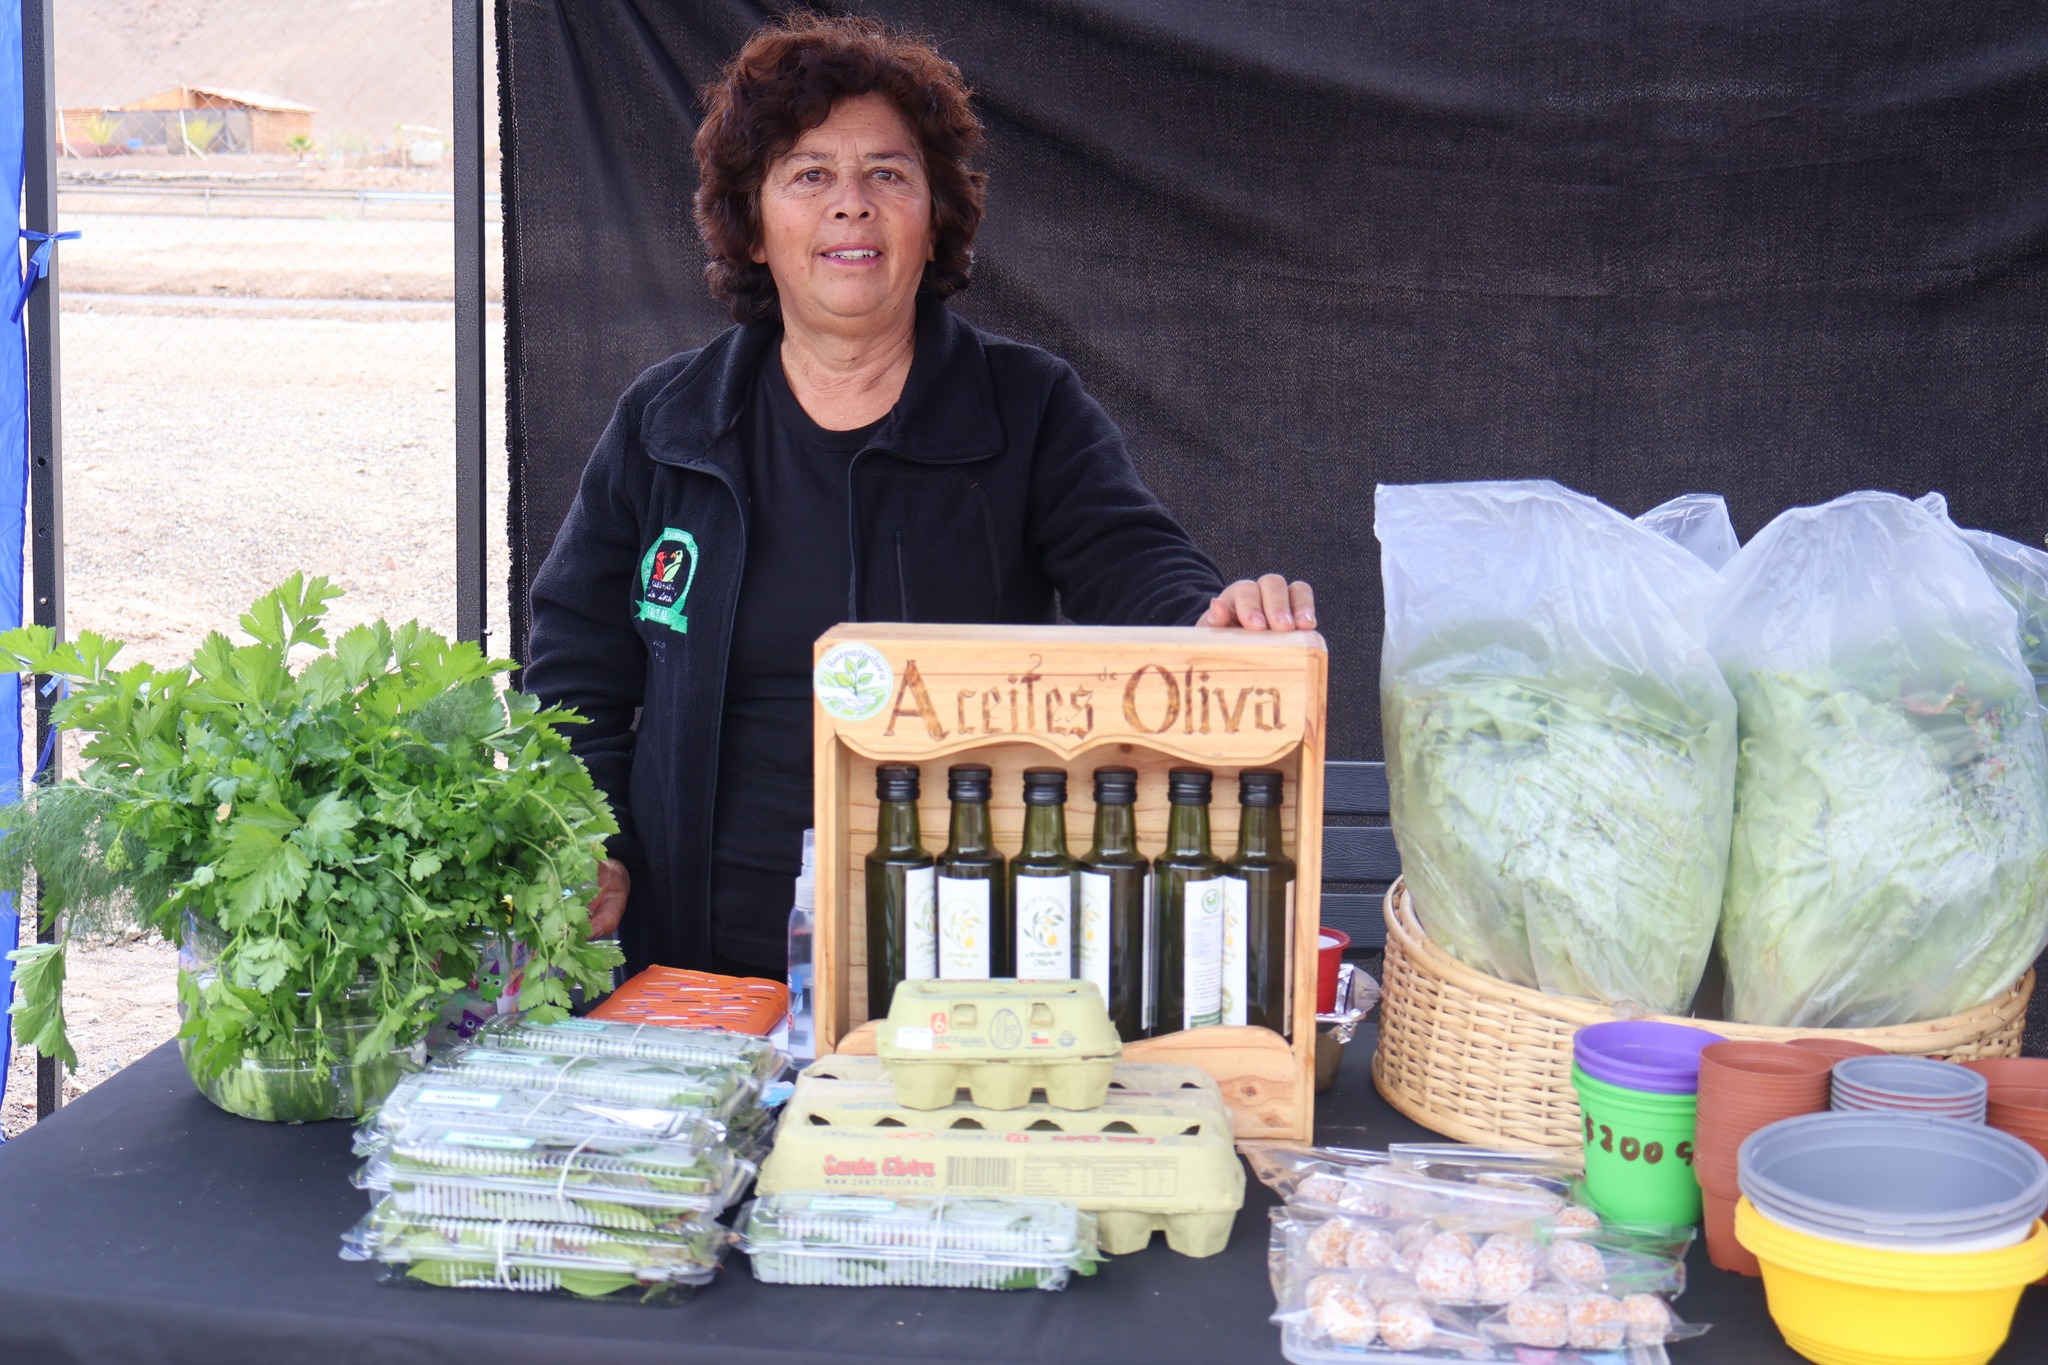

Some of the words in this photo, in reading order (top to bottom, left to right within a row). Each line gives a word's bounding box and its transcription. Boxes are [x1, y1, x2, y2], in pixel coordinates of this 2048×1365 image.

[826, 650, 886, 681] Buenaventura
[883, 653, 1094, 742] Aceites
[1097, 666, 1118, 682] de
[1122, 663, 1287, 735] Oliva
[933, 1013, 946, 1032] 6
[434, 1093, 482, 1103] ROMERO
[824, 1154, 878, 1177] Santa
[881, 1156, 936, 1178] Elvira
